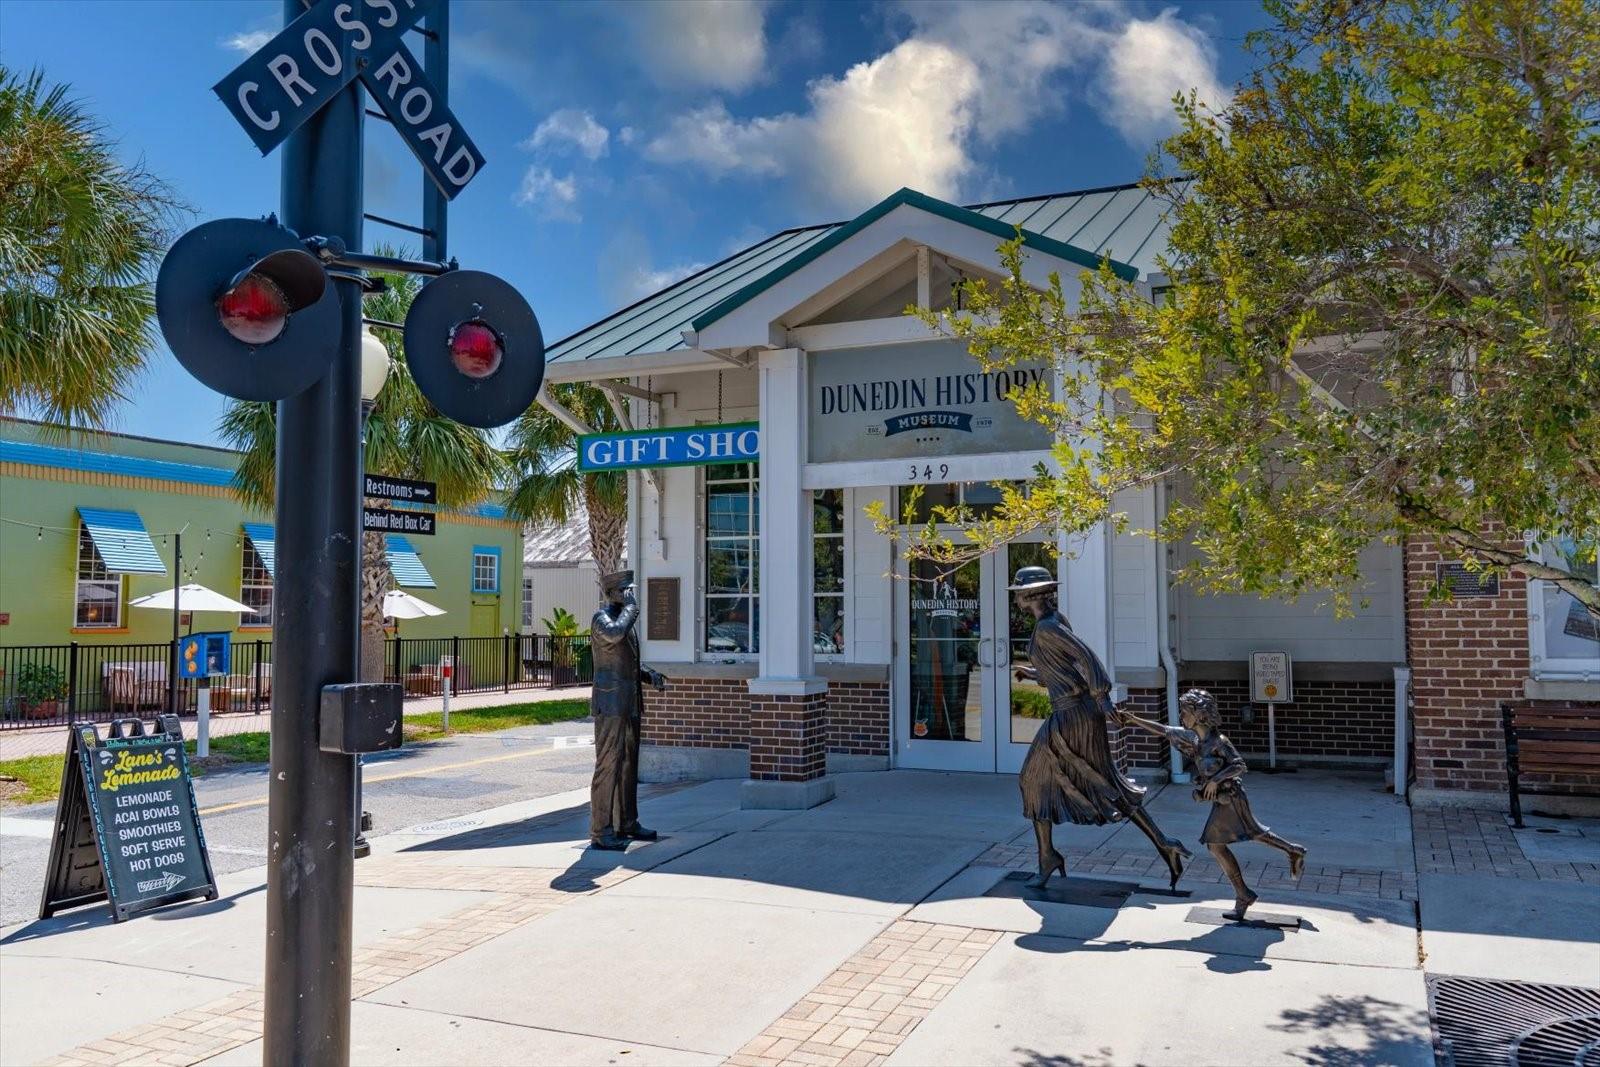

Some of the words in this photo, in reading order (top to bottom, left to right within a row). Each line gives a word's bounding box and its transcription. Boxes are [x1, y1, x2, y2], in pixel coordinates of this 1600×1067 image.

[237, 0, 415, 131] CROSS
[374, 51, 475, 186] ROAD
[821, 378, 927, 415] DUNEDIN
[936, 368, 1045, 406] HISTORY
[898, 414, 959, 429] MUSEUM
[587, 436, 675, 465] GIFT
[908, 464, 949, 480] 349
[366, 478, 413, 498] Restrooms
[364, 511, 388, 528] Behind
[390, 514, 403, 529] Red
[405, 515, 418, 530] Box
[419, 516, 432, 531] Car
[912, 600, 945, 610] DUNEDIN
[947, 599, 979, 610] HISTORY
[115, 750, 163, 773] Lane's
[101, 764, 181, 792] Lemonade
[116, 790, 173, 808] LEMONADE
[115, 809, 140, 825] ACAI
[143, 805, 180, 821] BOWLS
[119, 820, 182, 841] SMOOTHIES
[121, 842, 150, 857] SOFT
[151, 836, 186, 852] SERVE
[130, 858, 152, 873] HOT
[155, 852, 185, 868] DOGS
